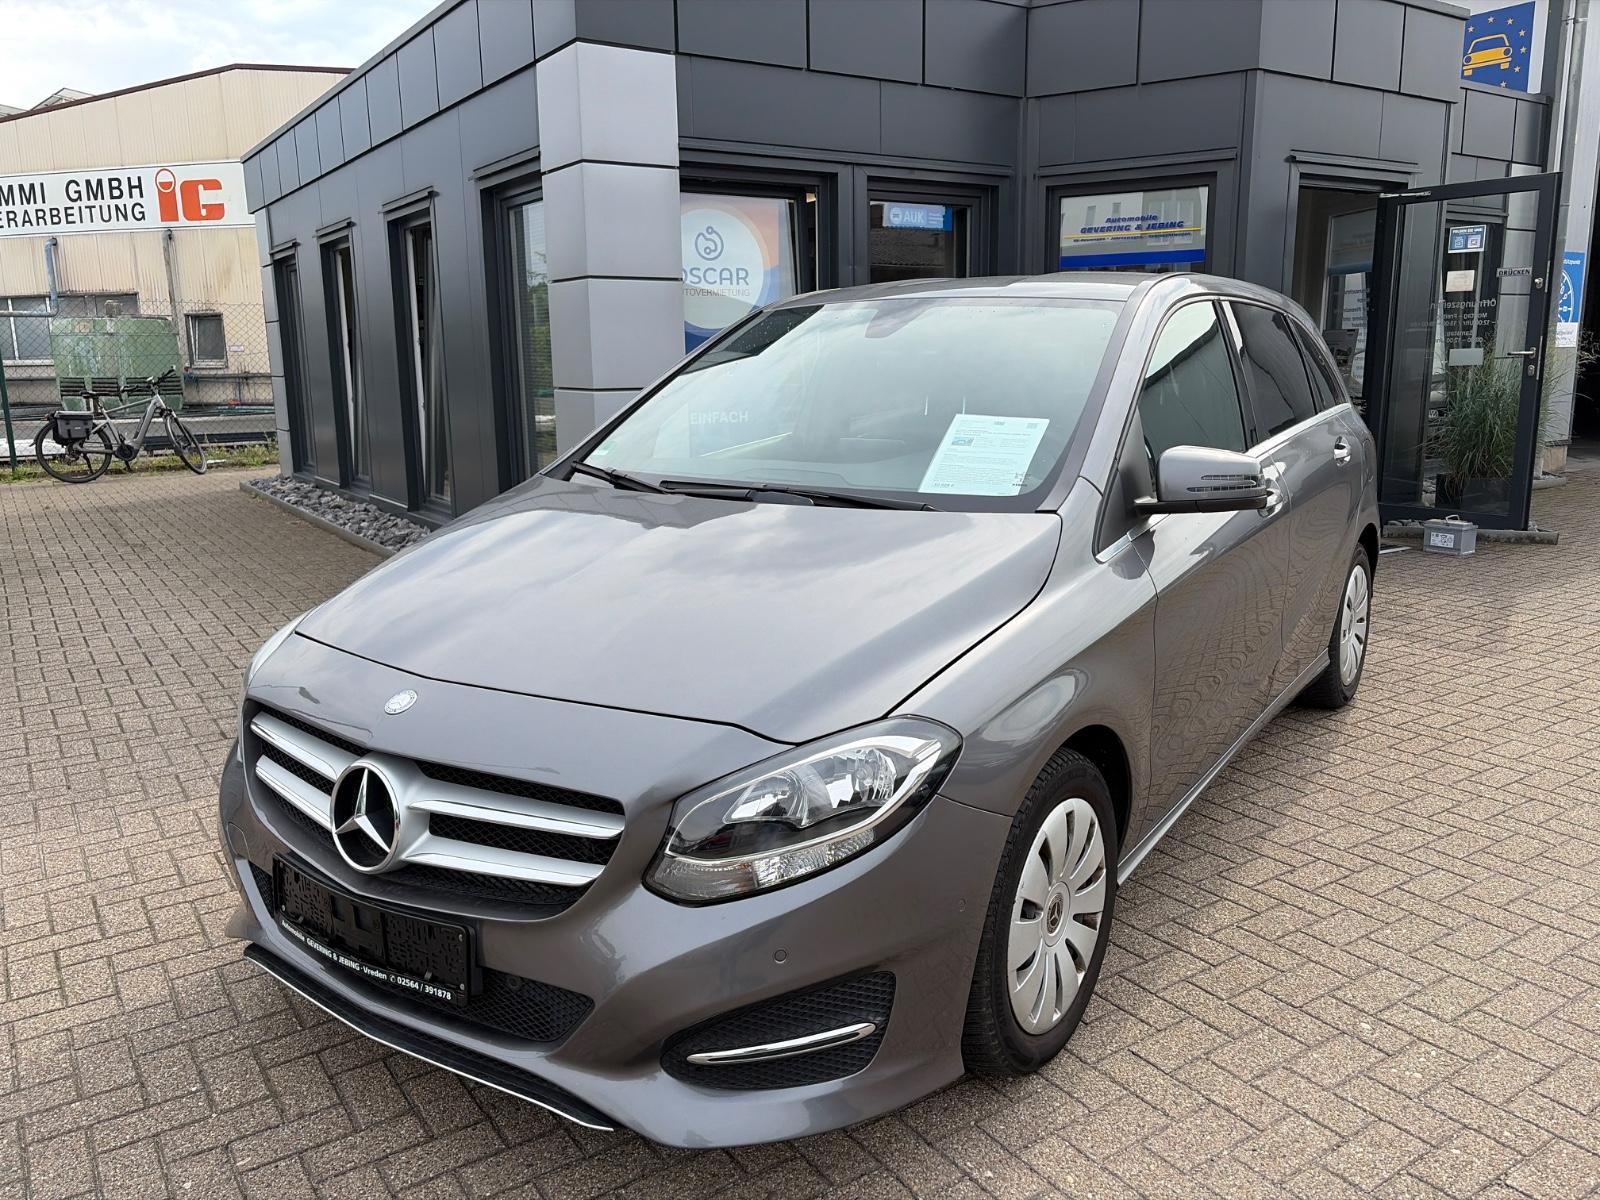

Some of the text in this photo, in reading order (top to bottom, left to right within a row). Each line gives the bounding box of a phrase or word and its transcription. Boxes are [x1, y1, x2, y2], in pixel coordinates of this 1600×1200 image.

[0, 176, 145, 206] MMI GMBH
[1105, 214, 1158, 224] Automobile
[1080, 220, 1184, 234] GEVERING & JEBING
[1499, 268, 1530, 277] DRÜCKEN
[682, 288, 750, 297] TOVERMIETUNG
[690, 411, 749, 425] EINFACH
[306, 937, 332, 959] GEVERING
[338, 956, 360, 971] JEBING
[363, 965, 388, 980] Vreden
[397, 976, 419, 991] 02564
[424, 985, 452, 1001] 391878
